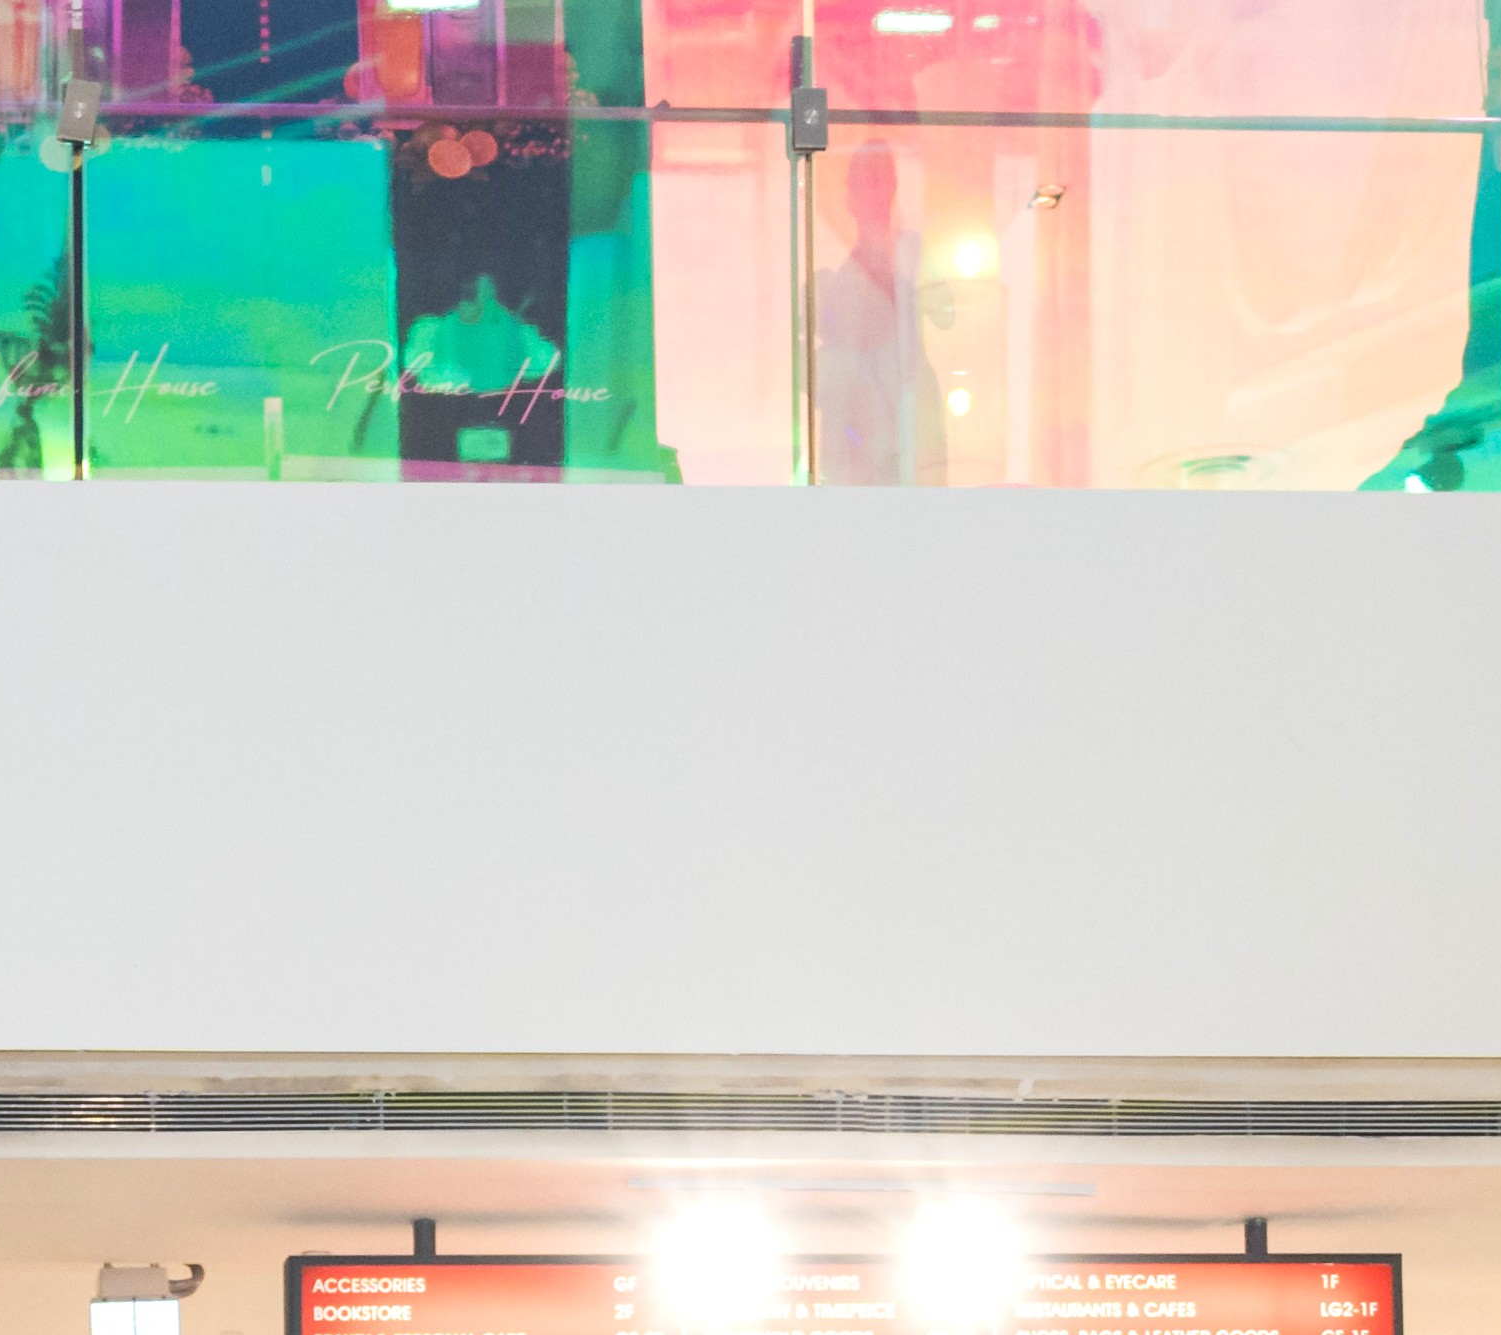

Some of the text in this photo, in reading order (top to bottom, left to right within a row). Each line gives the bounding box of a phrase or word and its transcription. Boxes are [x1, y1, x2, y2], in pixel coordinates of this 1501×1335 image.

[94, 343, 220, 424] House
[309, 339, 613, 424] Perfume House
[312, 1277, 426, 1293] ACCESSORIES
[613, 1276, 637, 1292] GF
[1087, 1275, 1100, 1289] &
[1105, 1275, 1176, 1290] EYECARE
[1321, 1275, 1339, 1288] 1F
[313, 1305, 412, 1322] BOOKSTORE
[614, 1304, 635, 1320] 2F
[1126, 1302, 1140, 1317] &
[1144, 1302, 1196, 1317] CAFES
[1321, 1303, 1378, 1317] LG2-1F
